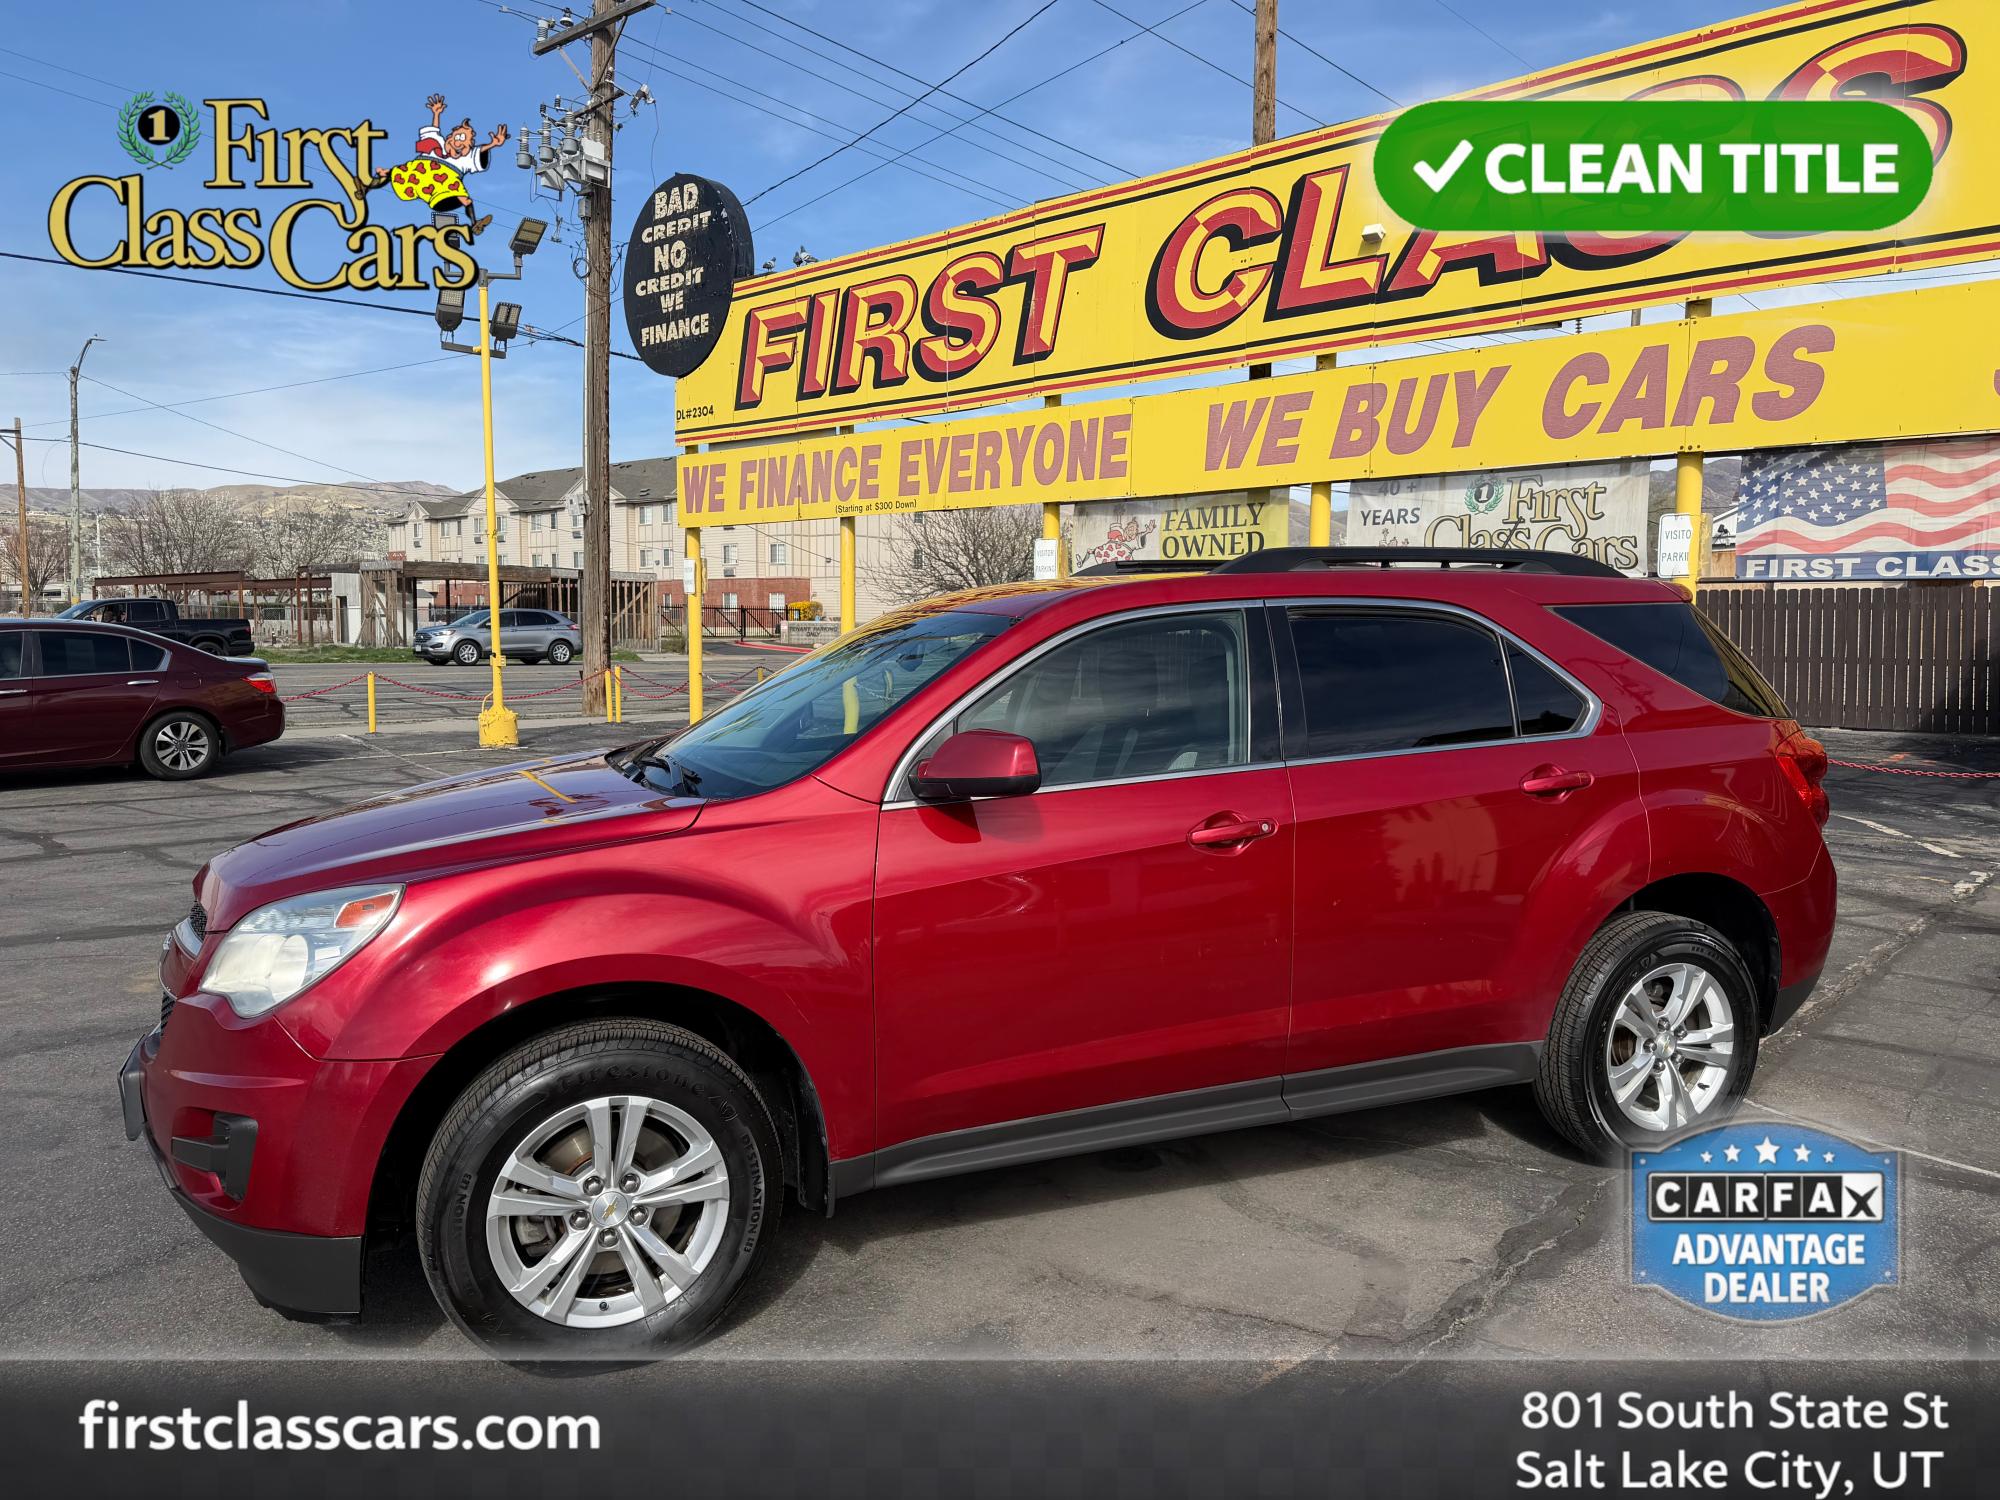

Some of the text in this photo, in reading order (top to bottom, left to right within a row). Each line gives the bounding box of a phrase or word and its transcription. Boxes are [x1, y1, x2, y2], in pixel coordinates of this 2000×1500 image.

[653, 182, 700, 221] BAD
[641, 210, 712, 244] CREDIT
[653, 239, 687, 274] NO
[635, 266, 705, 297] CREDIT
[660, 290, 684, 314] WE
[735, 224, 1105, 410] FIRST
[640, 312, 710, 347] FINANCE
[676, 406, 715, 421] DL#2304
[1204, 323, 1837, 472] WE BUY CARS
[682, 413, 1132, 514] WE FINANCE EVERYONE
[1163, 502, 1267, 532] FAMILY
[1360, 507, 1421, 526] YEARS
[1502, 474, 1607, 541] First
[1162, 531, 1265, 560] OWNED
[1424, 513, 1639, 570] Class Cars
[1665, 529, 1692, 540] VISITO
[1661, 551, 1689, 562] PARKI
[1746, 557, 1861, 579] FIRST
